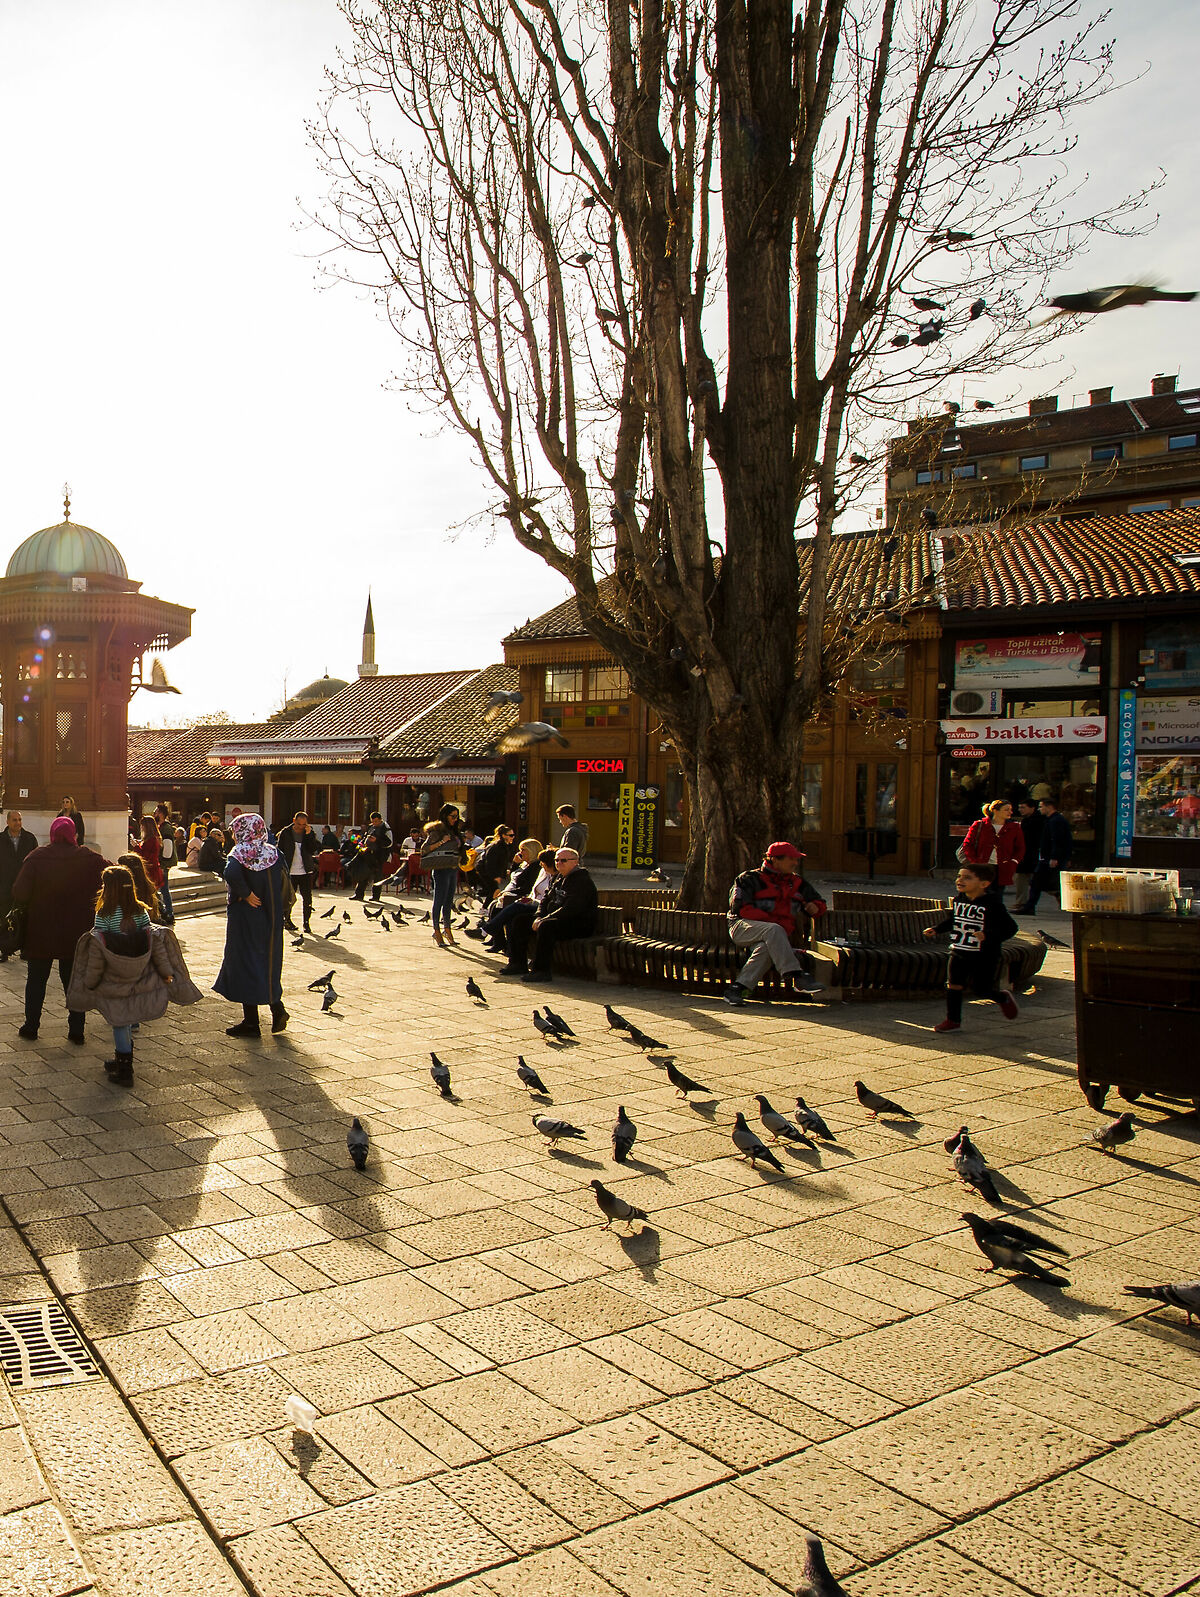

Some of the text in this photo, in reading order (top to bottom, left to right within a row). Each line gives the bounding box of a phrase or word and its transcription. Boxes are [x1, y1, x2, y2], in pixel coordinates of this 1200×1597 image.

[1007, 637, 1064, 649] Topli užitak
[994, 649, 1003, 657] iz
[1006, 648, 1038, 657] Turske
[1050, 645, 1080, 655] Bosni
[984, 724, 1064, 739] bakkal
[1122, 703, 1132, 765] PRODAJA
[1141, 735, 1200, 744] NOKIA
[576, 759, 624, 772] EXCHA
[1120, 784, 1131, 845] ZAMJENA
[620, 788, 630, 864] EXCHANGE
